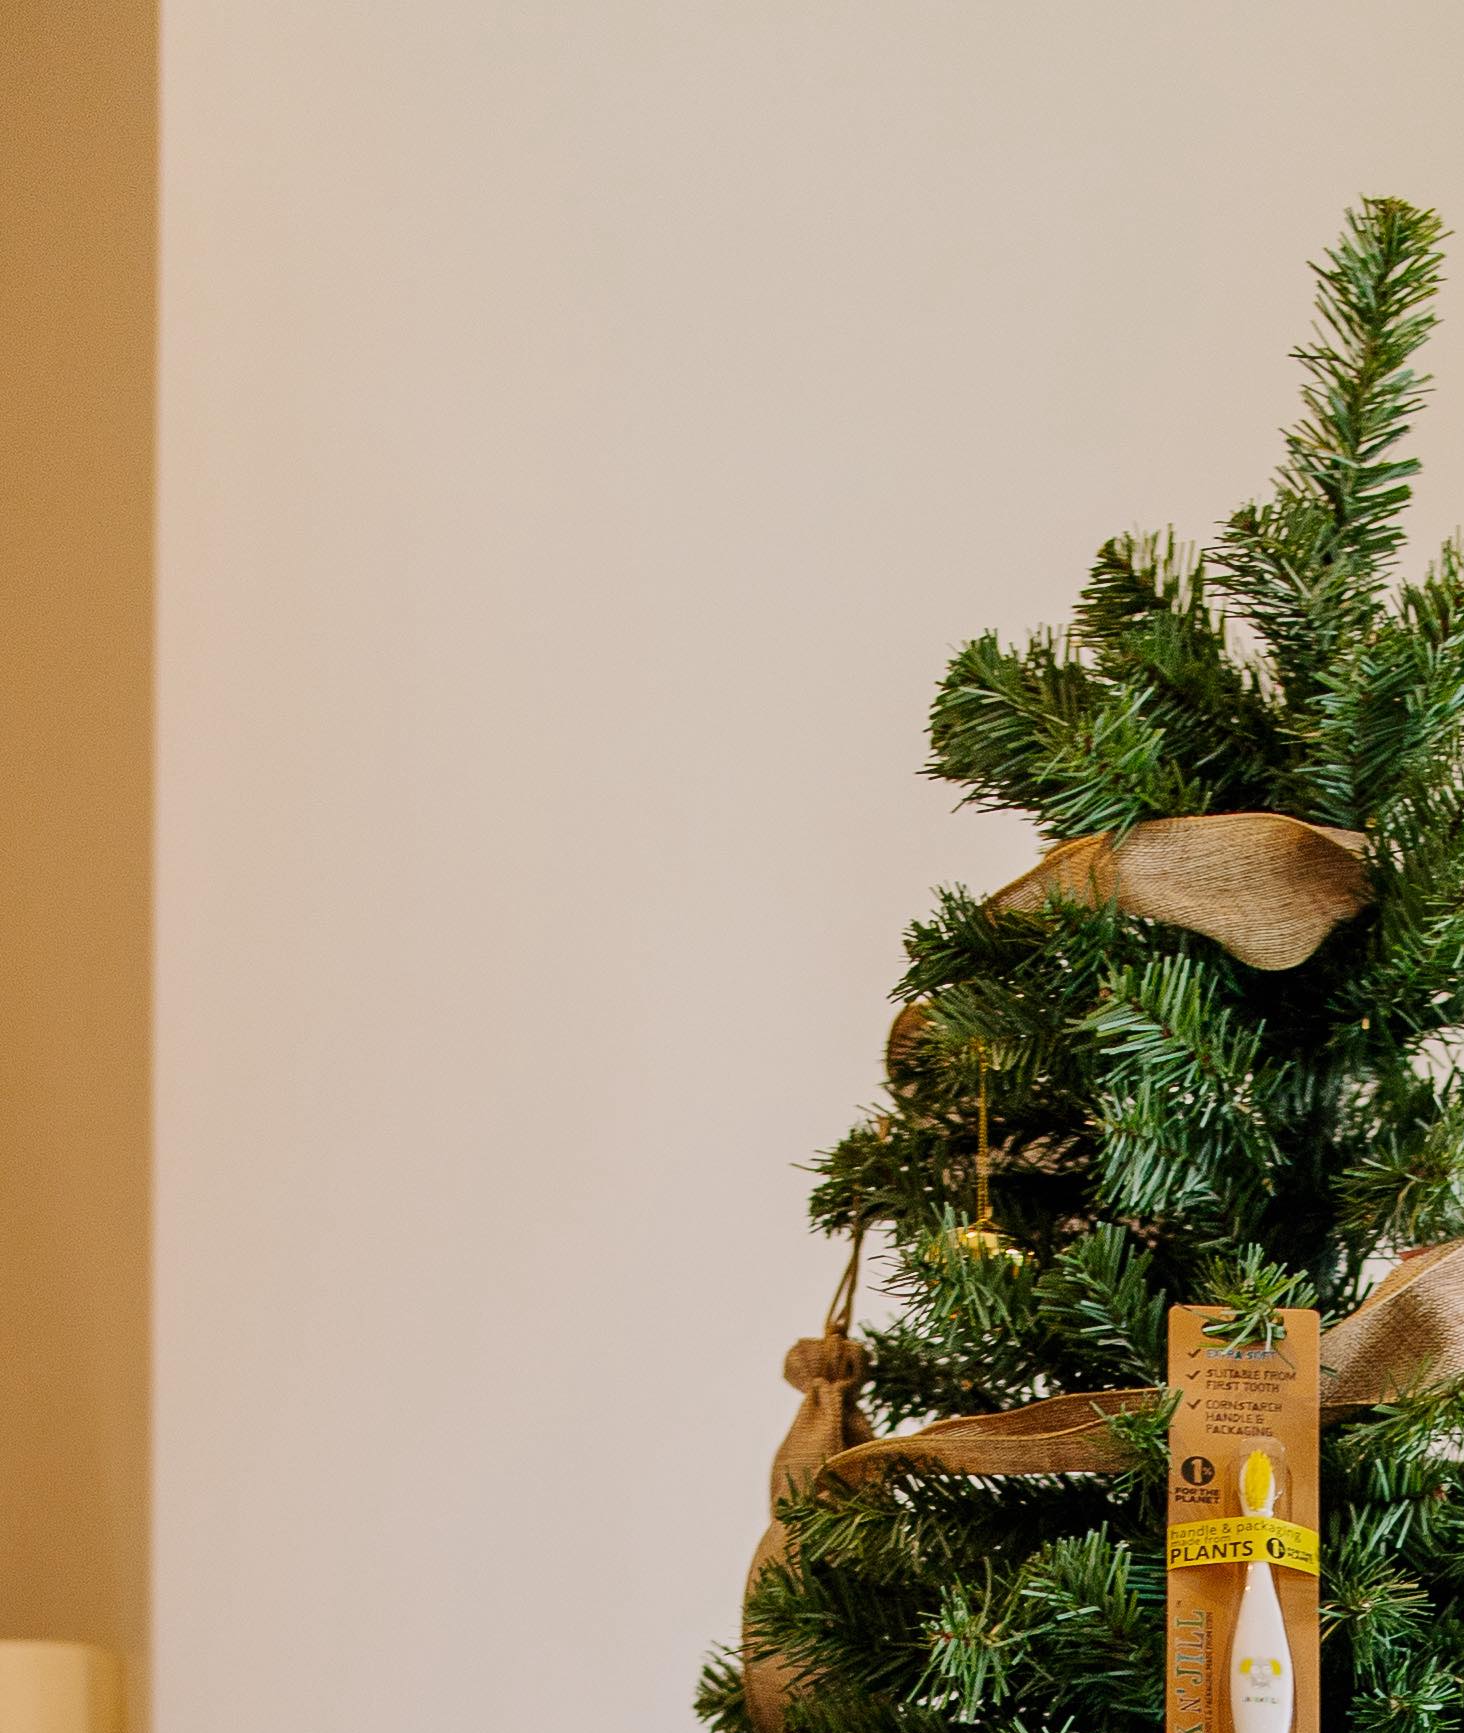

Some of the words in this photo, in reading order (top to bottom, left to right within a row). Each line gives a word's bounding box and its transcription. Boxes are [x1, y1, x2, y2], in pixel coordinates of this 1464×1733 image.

[1205, 1368, 1260, 1381] SUITABLE
[1262, 1370, 1297, 1382] FROM
[1205, 1380, 1239, 1392] FIRST
[1205, 1400, 1282, 1413] CORNSTARCH
[1205, 1424, 1273, 1437] PACKAGING
[1170, 1523, 1217, 1539] handle
[1221, 1523, 1232, 1535] &
[1236, 1520, 1303, 1543] packaging
[1170, 1540, 1254, 1564] PLANTS
[1173, 1609, 1206, 1686] JILL
